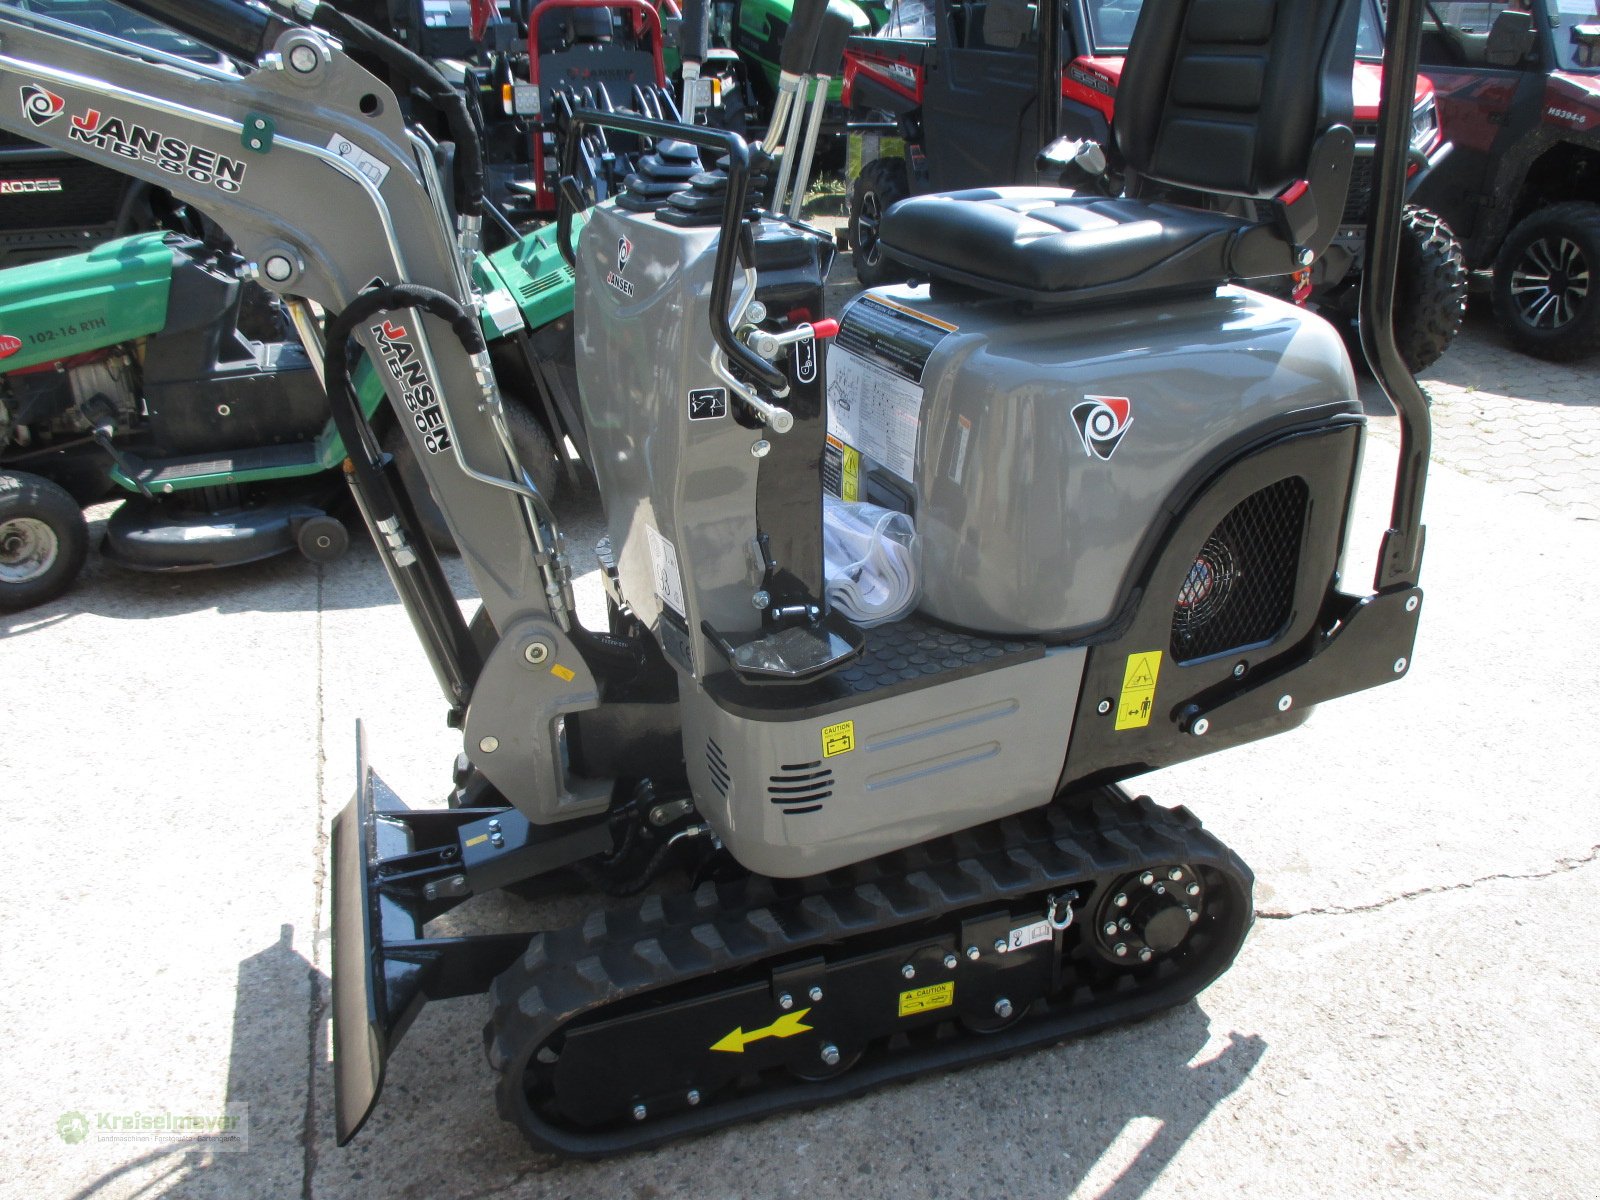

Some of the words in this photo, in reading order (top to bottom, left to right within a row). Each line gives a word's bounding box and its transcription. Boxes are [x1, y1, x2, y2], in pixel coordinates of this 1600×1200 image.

[69, 126, 241, 193] MB-800
[71, 108, 247, 184] JANSEN
[607, 271, 635, 298] JANSEN
[29, 325, 78, 344] 102-16
[370, 324, 439, 455] MB-800
[382, 320, 453, 453] JANSEN
[824, 723, 851, 735] CAUTION
[916, 985, 946, 997] CAUTION
